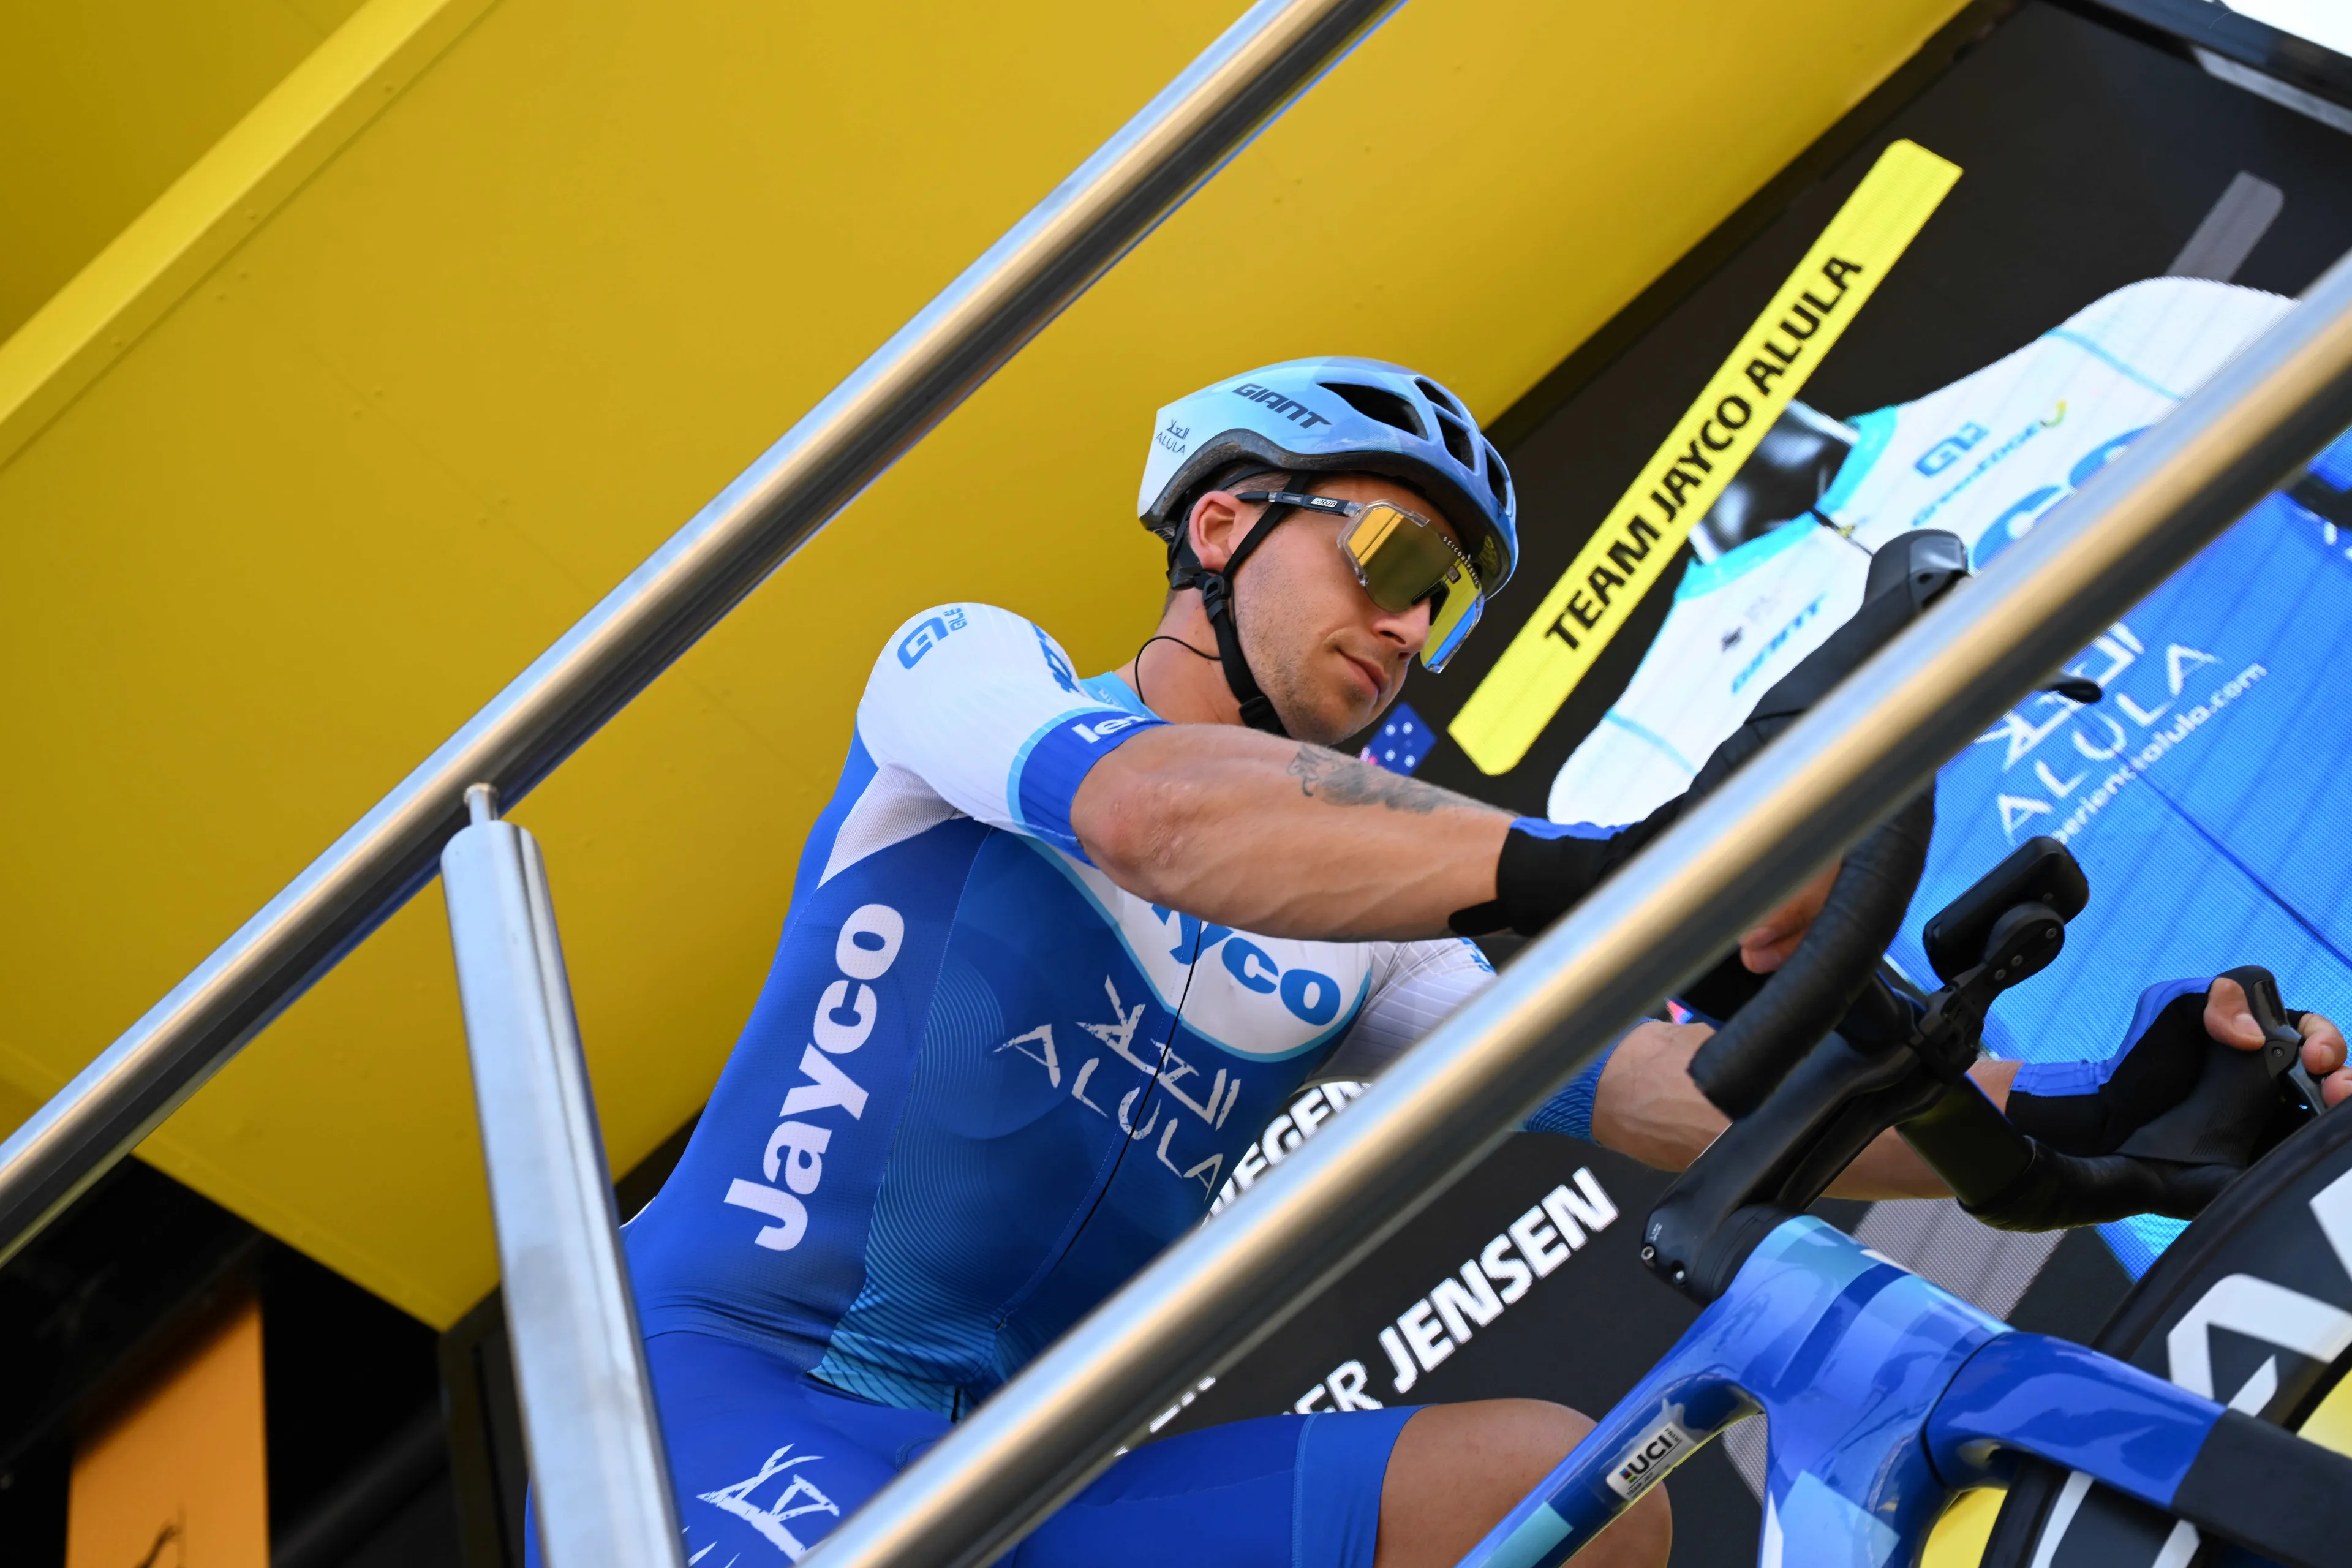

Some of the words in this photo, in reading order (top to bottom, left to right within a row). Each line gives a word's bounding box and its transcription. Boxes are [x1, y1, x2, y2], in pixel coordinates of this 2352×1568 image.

[1155, 431, 1185, 456] ALULA
[1232, 383, 1333, 429] GIANT
[1544, 514, 1662, 650] TEAM
[1660, 394, 1752, 522] JAYCO
[1744, 255, 1863, 394] ALULA
[1997, 641, 2225, 848] ALULA
[723, 903, 905, 1251] Jayco
[992, 1023, 1223, 1204] ALULA
[1378, 1166, 1619, 1394] JENSEN
[1627, 1435, 1673, 1474] UCI
